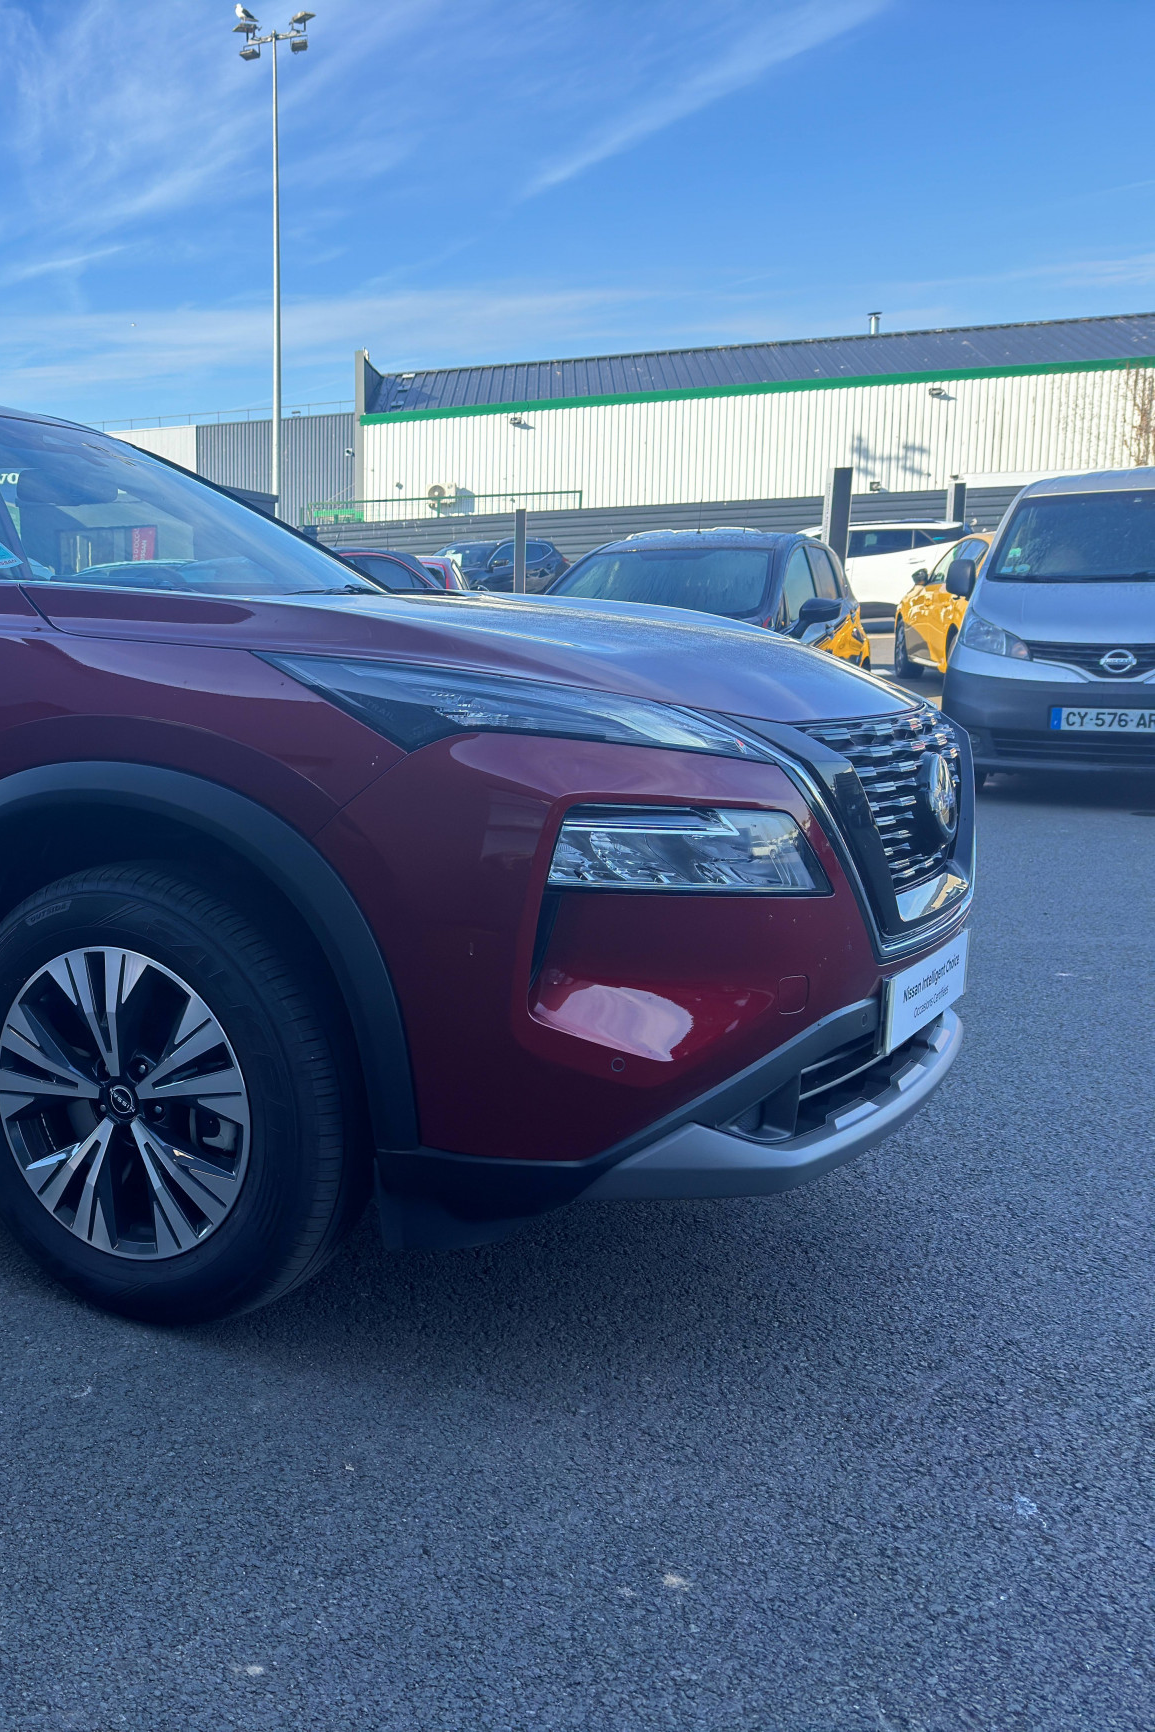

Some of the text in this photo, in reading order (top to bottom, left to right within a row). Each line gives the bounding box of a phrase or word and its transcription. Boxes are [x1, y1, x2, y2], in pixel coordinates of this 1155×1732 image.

[903, 955, 959, 1003] Nissan Intelligent Choice
[914, 997, 933, 1018] Occasions
[110, 1087, 136, 1113] NISSAN
